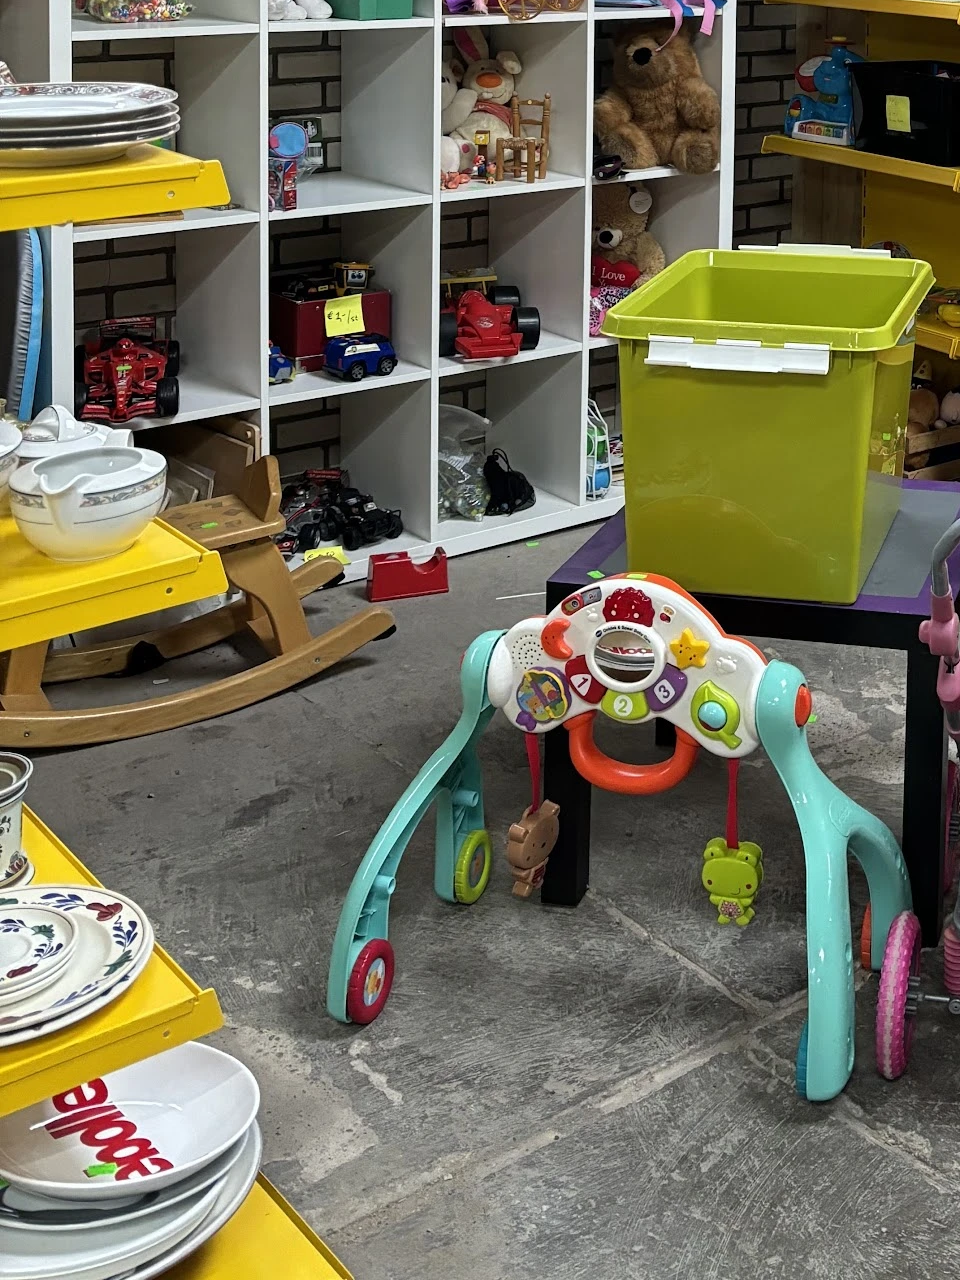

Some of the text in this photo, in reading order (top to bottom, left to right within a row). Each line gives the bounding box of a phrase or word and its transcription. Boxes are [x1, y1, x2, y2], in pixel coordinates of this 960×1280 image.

[600, 267, 626, 282] Love
[577, 677, 588, 689] 1
[658, 684, 671, 699] 3
[617, 698, 628, 713] 2
